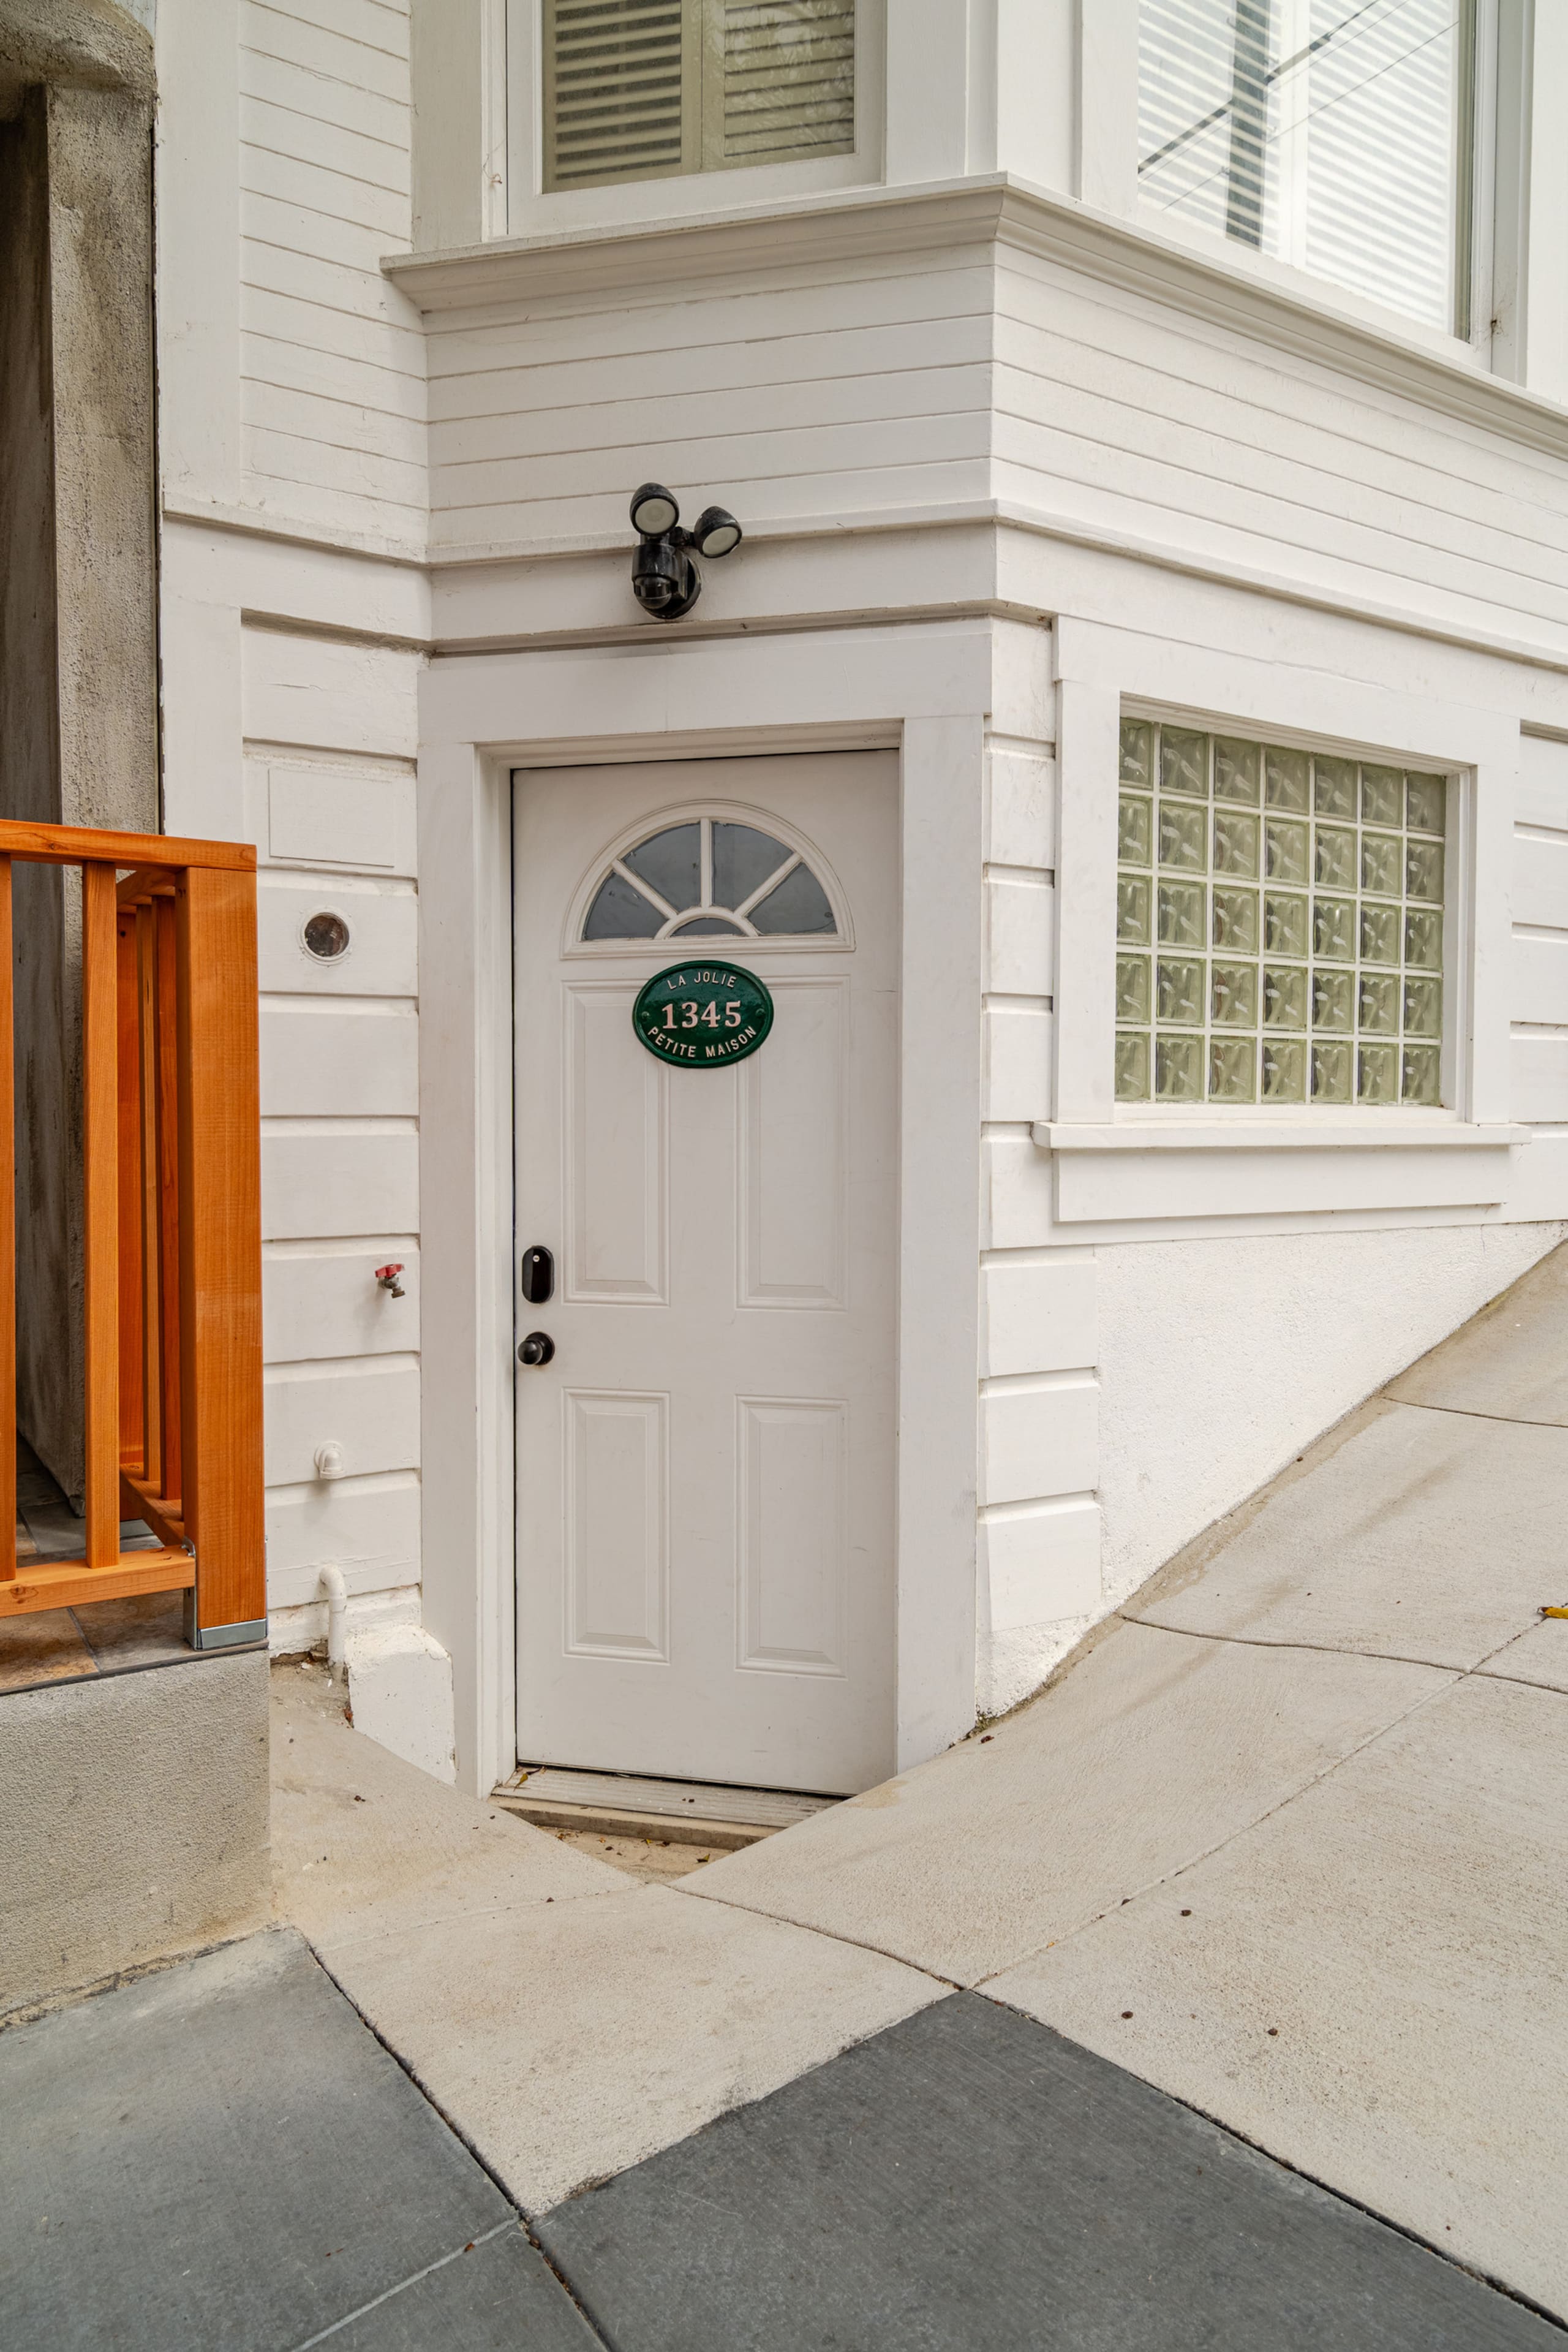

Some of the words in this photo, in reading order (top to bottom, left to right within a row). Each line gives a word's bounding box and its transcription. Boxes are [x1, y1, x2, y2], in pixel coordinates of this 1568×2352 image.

[667, 975, 686, 989] LA
[694, 972, 737, 988] JOLIE
[662, 1000, 741, 1029] 1345
[647, 1026, 696, 1057] PETITE
[706, 1026, 756, 1057] MAISON
